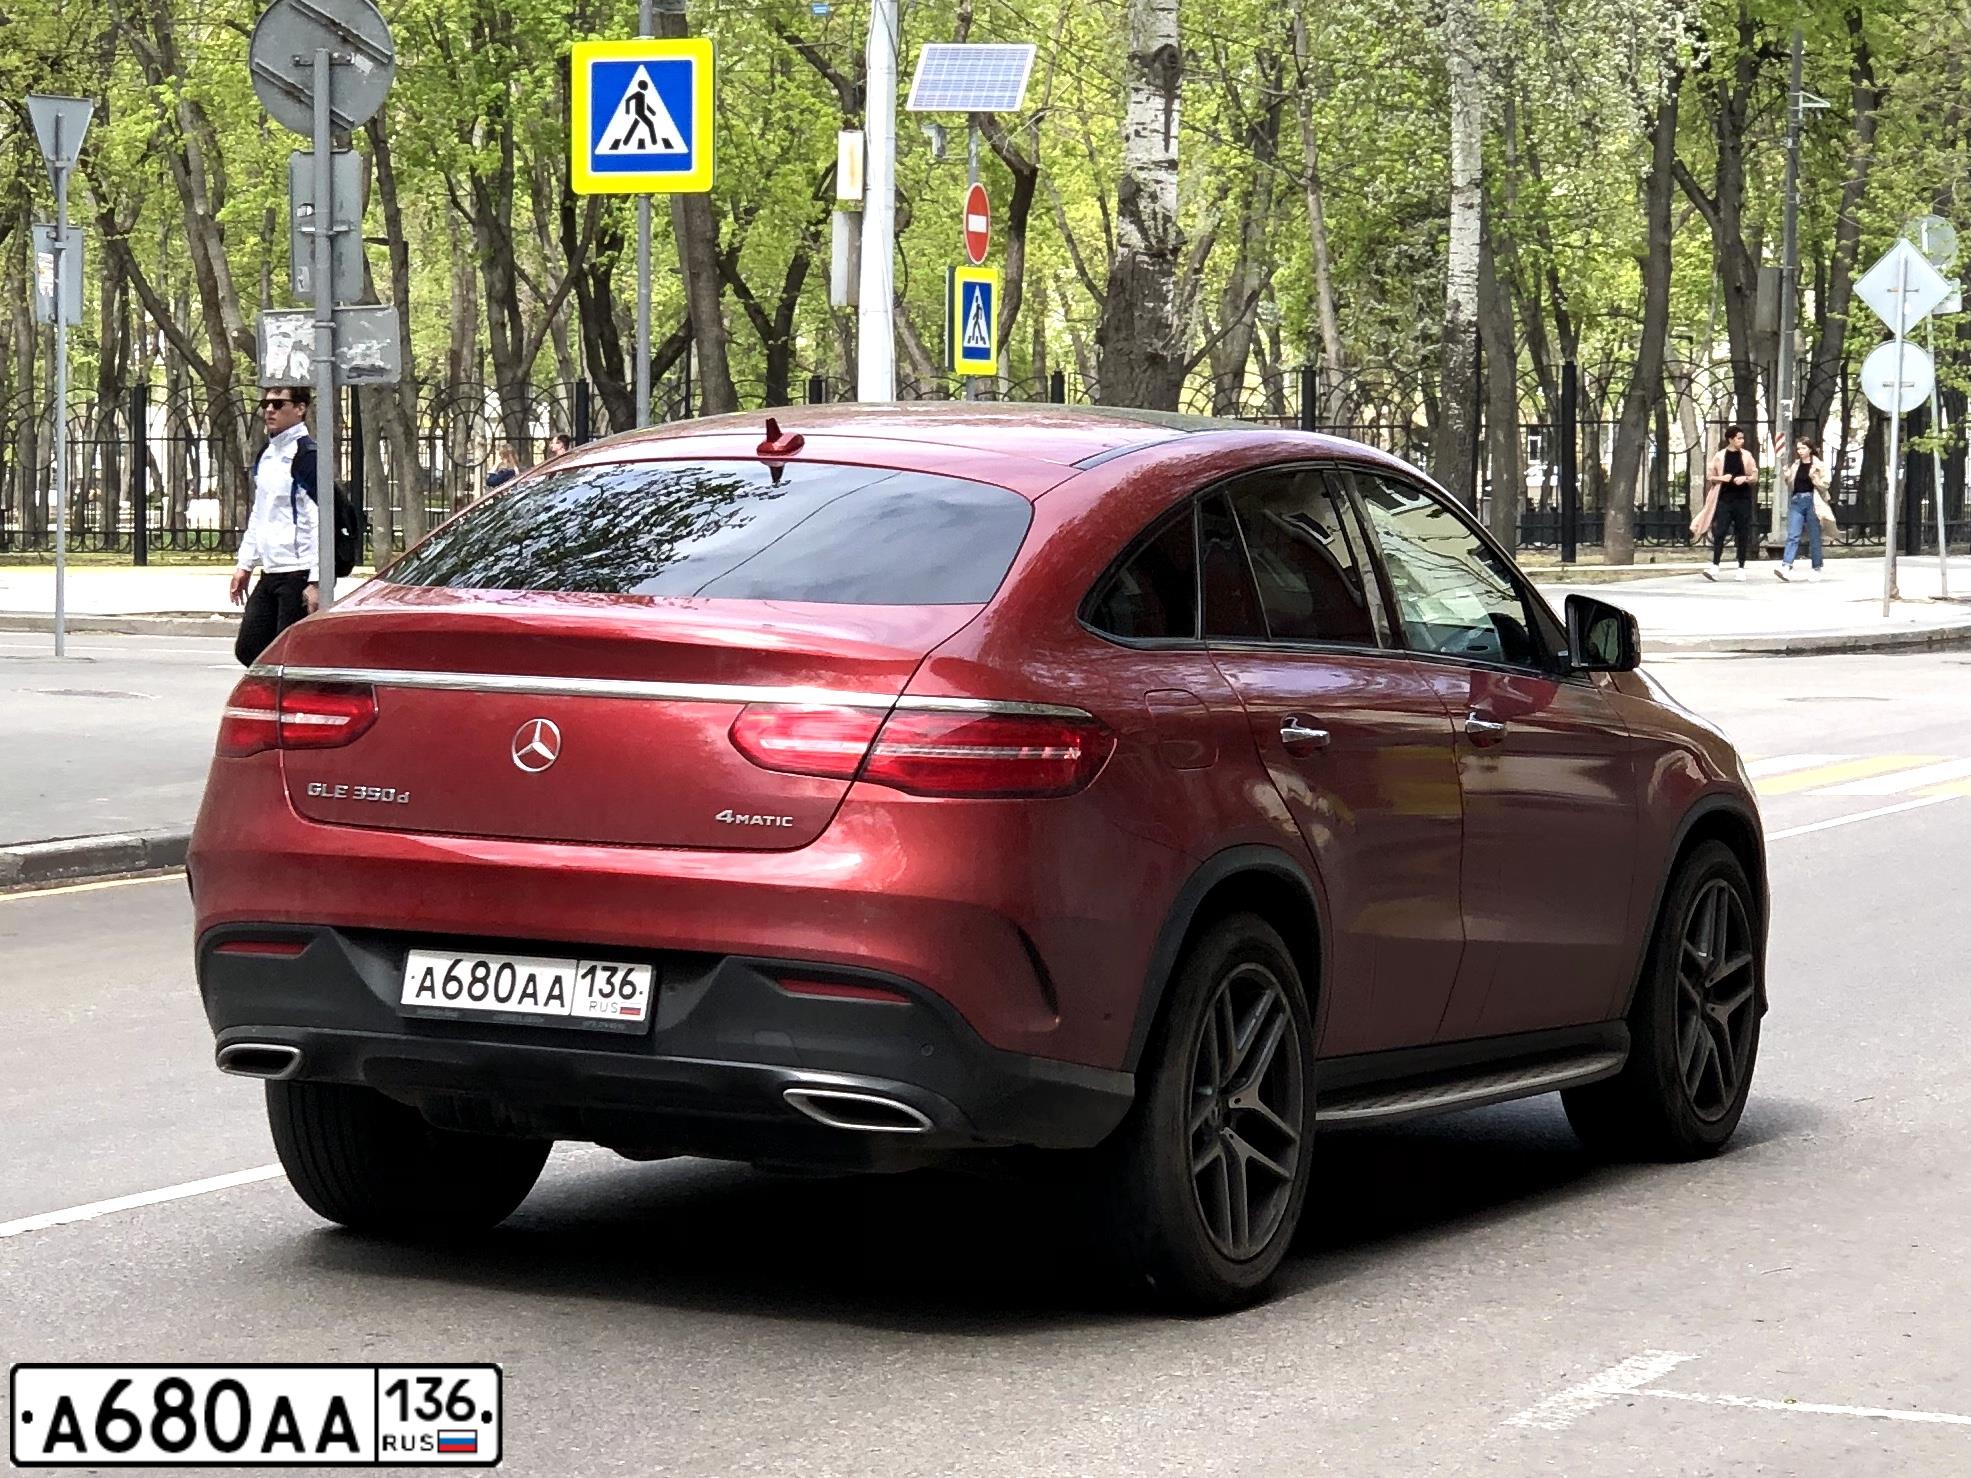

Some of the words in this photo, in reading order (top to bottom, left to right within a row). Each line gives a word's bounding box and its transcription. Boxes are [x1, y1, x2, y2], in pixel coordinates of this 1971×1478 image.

[307, 782, 349, 798] GLE
[715, 809, 794, 827] 4MATIC
[415, 958, 566, 1007] A680AA
[580, 964, 637, 1000] 136
[588, 1000, 619, 1014] RUS
